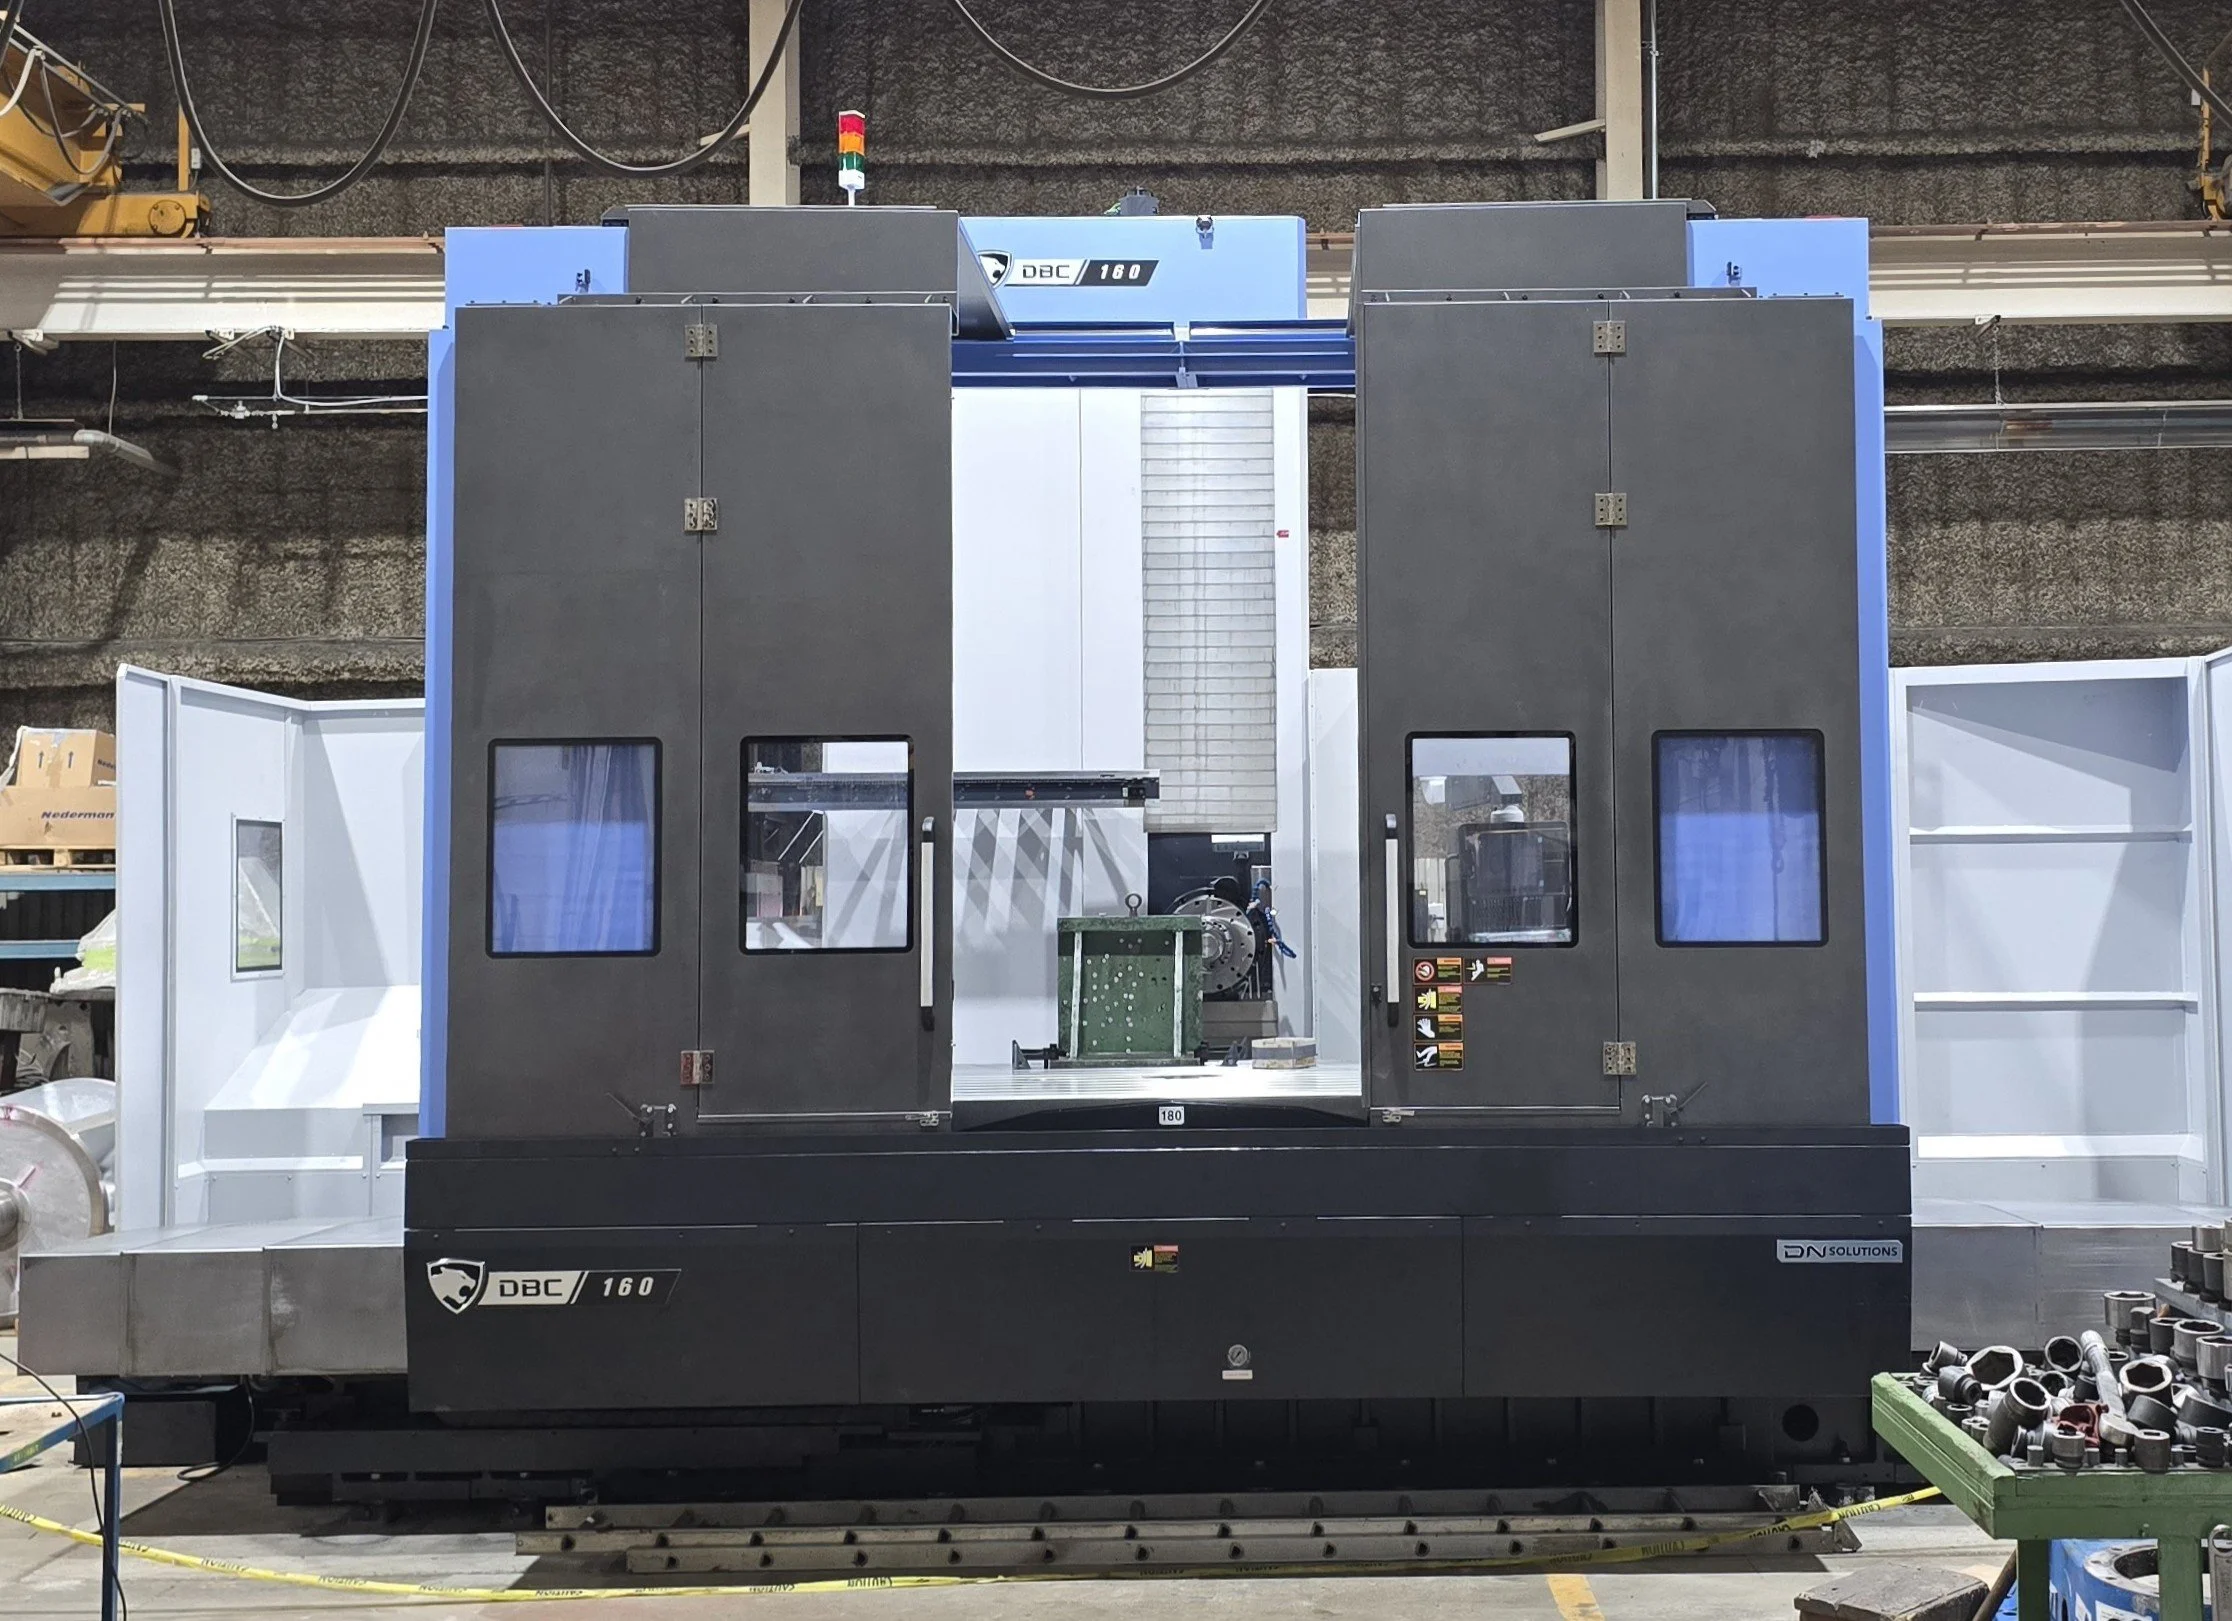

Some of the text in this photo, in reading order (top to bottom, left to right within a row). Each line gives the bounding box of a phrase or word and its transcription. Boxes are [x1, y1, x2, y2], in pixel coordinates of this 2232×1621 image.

[1022, 264, 1141, 280] DBC 160
[41, 810, 115, 819] Nederman
[1161, 1110, 1182, 1121] 180
[1784, 1245, 1897, 1258] DN SOLUTIONS
[499, 1276, 655, 1298] DBC 160
